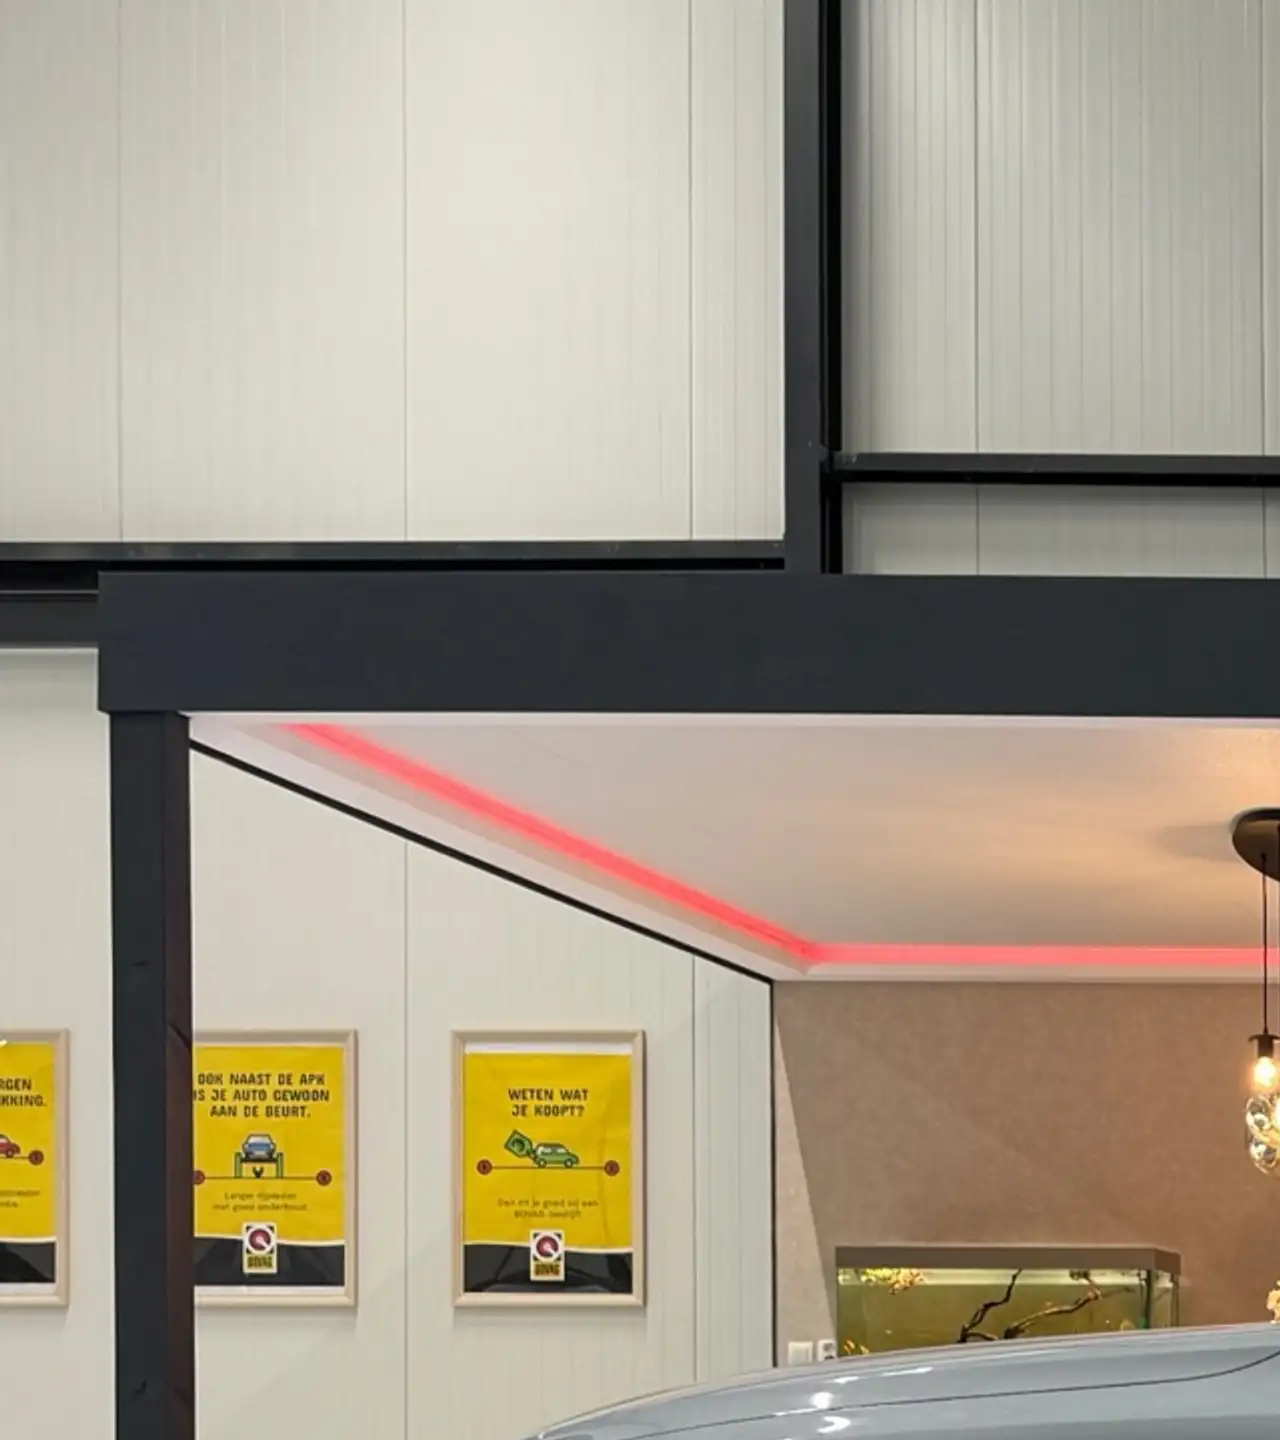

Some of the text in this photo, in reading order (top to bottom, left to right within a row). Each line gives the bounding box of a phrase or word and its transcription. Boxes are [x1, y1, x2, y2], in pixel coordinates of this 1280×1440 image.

[229, 1073, 271, 1085] NAAST
[277, 1073, 293, 1085] DE
[299, 1073, 325, 1085] APK
[210, 1089, 227, 1101] JE
[233, 1089, 268, 1101] AUTO
[273, 1089, 330, 1102] GEWOON
[508, 1087, 589, 1101] WETEN WAT
[210, 1105, 311, 1118] AAN DE BEURT.
[512, 1104, 585, 1117] JE KOOPT?
